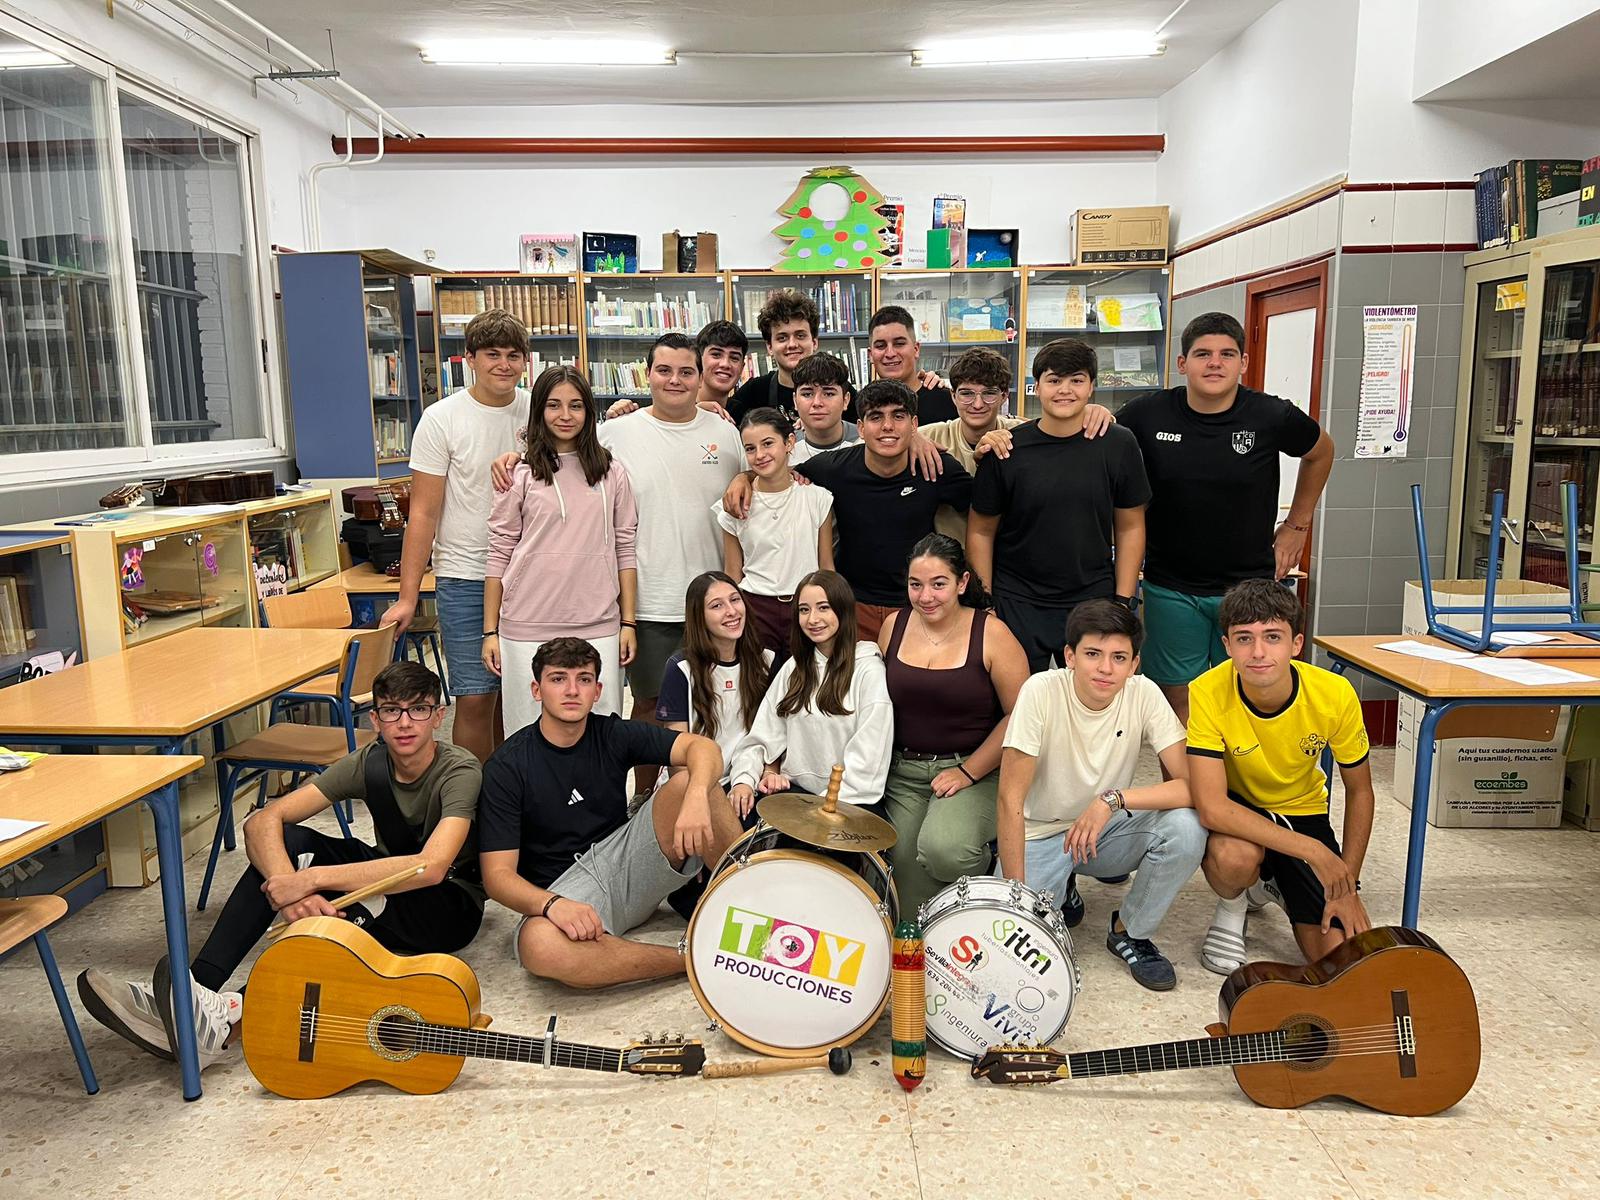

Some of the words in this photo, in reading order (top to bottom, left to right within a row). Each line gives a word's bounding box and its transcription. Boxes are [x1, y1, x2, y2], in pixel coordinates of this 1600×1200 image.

[1364, 307, 1417, 317] VIOLENTÓMETRO
[1156, 431, 1182, 442] GIOS
[1476, 780, 1526, 788] ecoembes
[730, 908, 861, 980] TOY
[713, 954, 853, 1004] PRODUCCIONES
